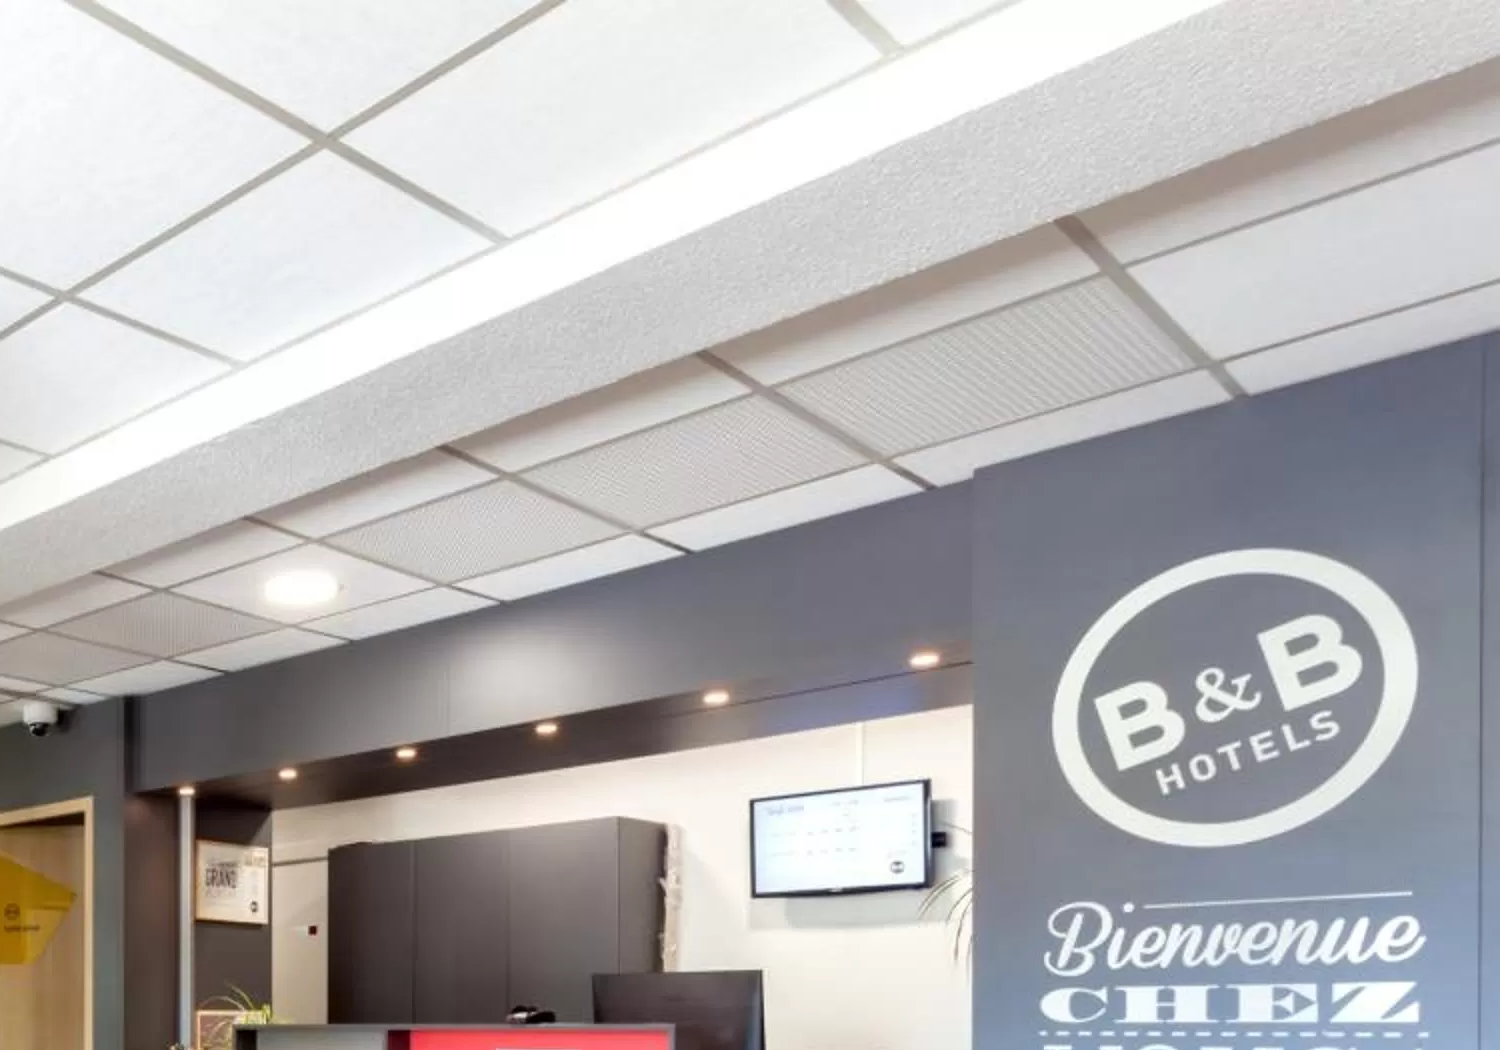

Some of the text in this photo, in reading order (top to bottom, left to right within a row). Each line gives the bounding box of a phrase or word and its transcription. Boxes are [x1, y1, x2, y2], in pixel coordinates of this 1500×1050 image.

[1094, 614, 1363, 772] B&B
[1156, 710, 1340, 795] HOTELS
[1044, 901, 1425, 977] Bienvenue
[1039, 982, 1421, 1024] CHEZ
